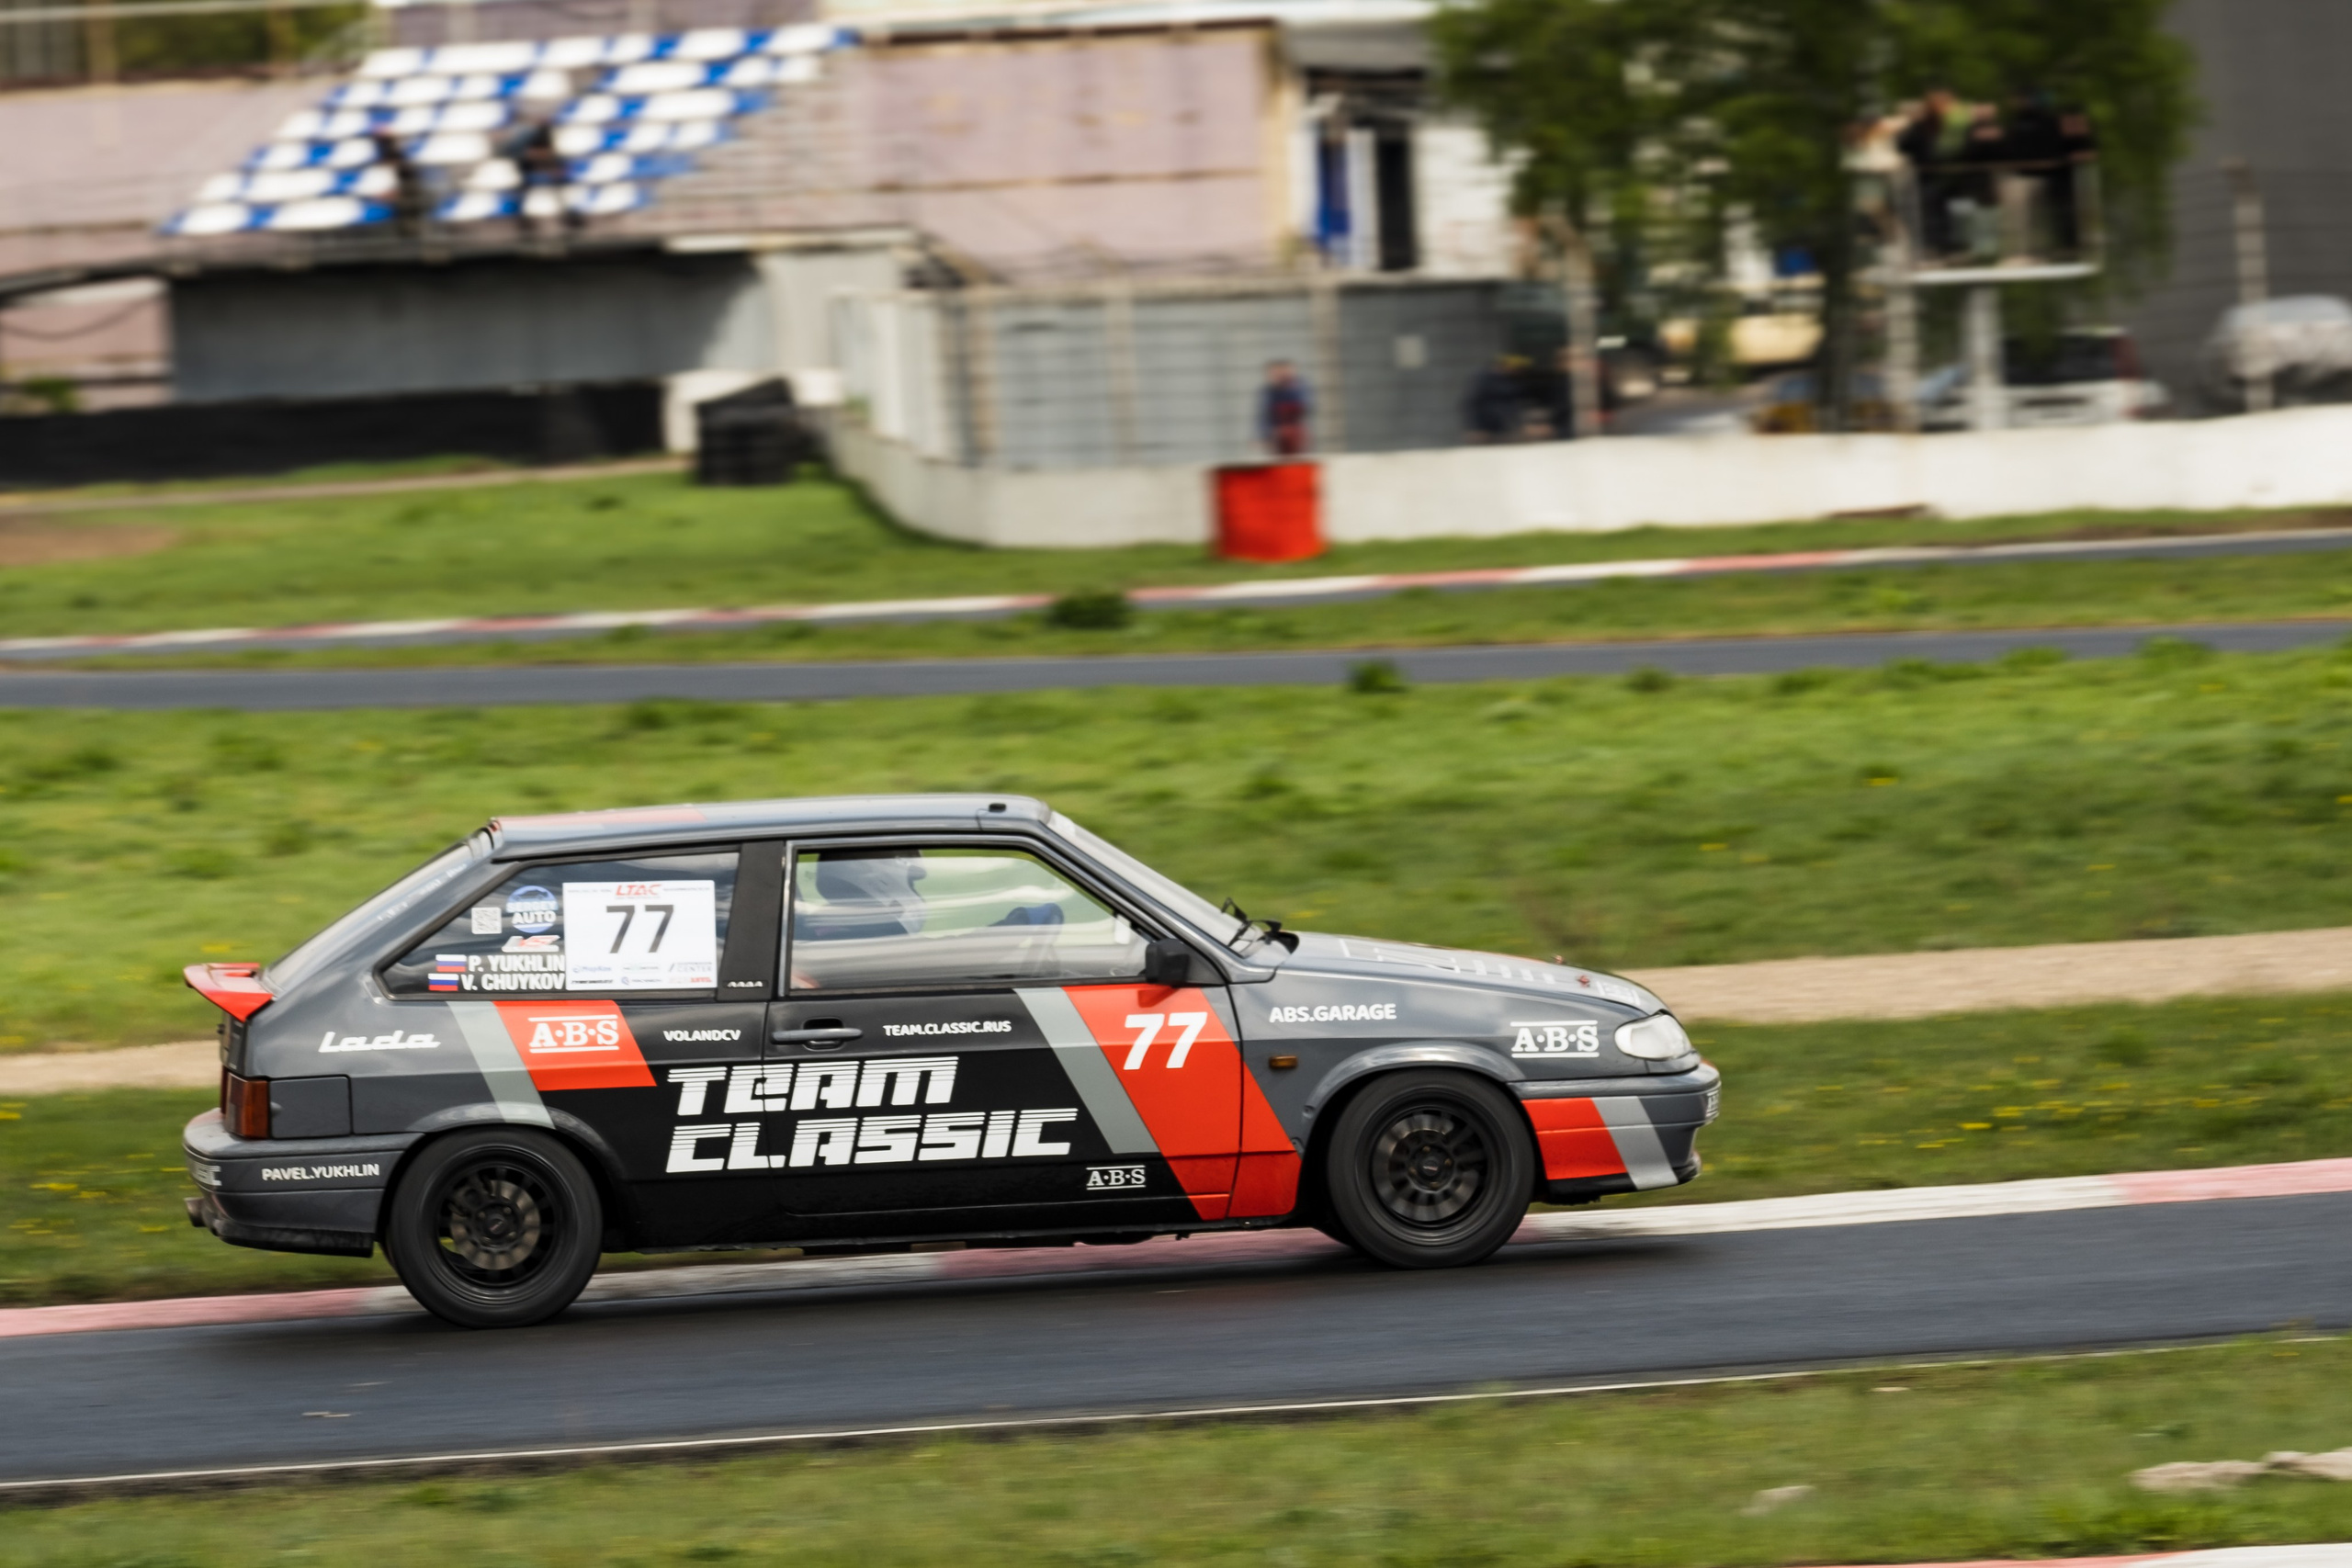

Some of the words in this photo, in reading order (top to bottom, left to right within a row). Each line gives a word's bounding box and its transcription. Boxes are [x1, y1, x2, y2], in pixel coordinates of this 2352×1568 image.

[616, 884, 662, 896] LTAC
[512, 910, 557, 924] AUTO
[606, 905, 674, 954] 77
[468, 955, 484, 972] P.
[487, 954, 565, 972] YUKHLIN
[460, 974, 479, 991] V.
[481, 973, 565, 990] CHUYKOV
[1270, 1003, 1397, 1023] ABS.GARAGE
[663, 1029, 741, 1043] VOLANDCV
[883, 1021, 1012, 1036] TEAM.CLASSIC.RUS
[318, 1030, 441, 1053] Lada
[1123, 1011, 1208, 1070] 77
[667, 1056, 959, 1116] TEAM
[665, 1108, 1080, 1173] CLASSIC
[261, 1163, 380, 1181] PAVEL.YUKHLIN
